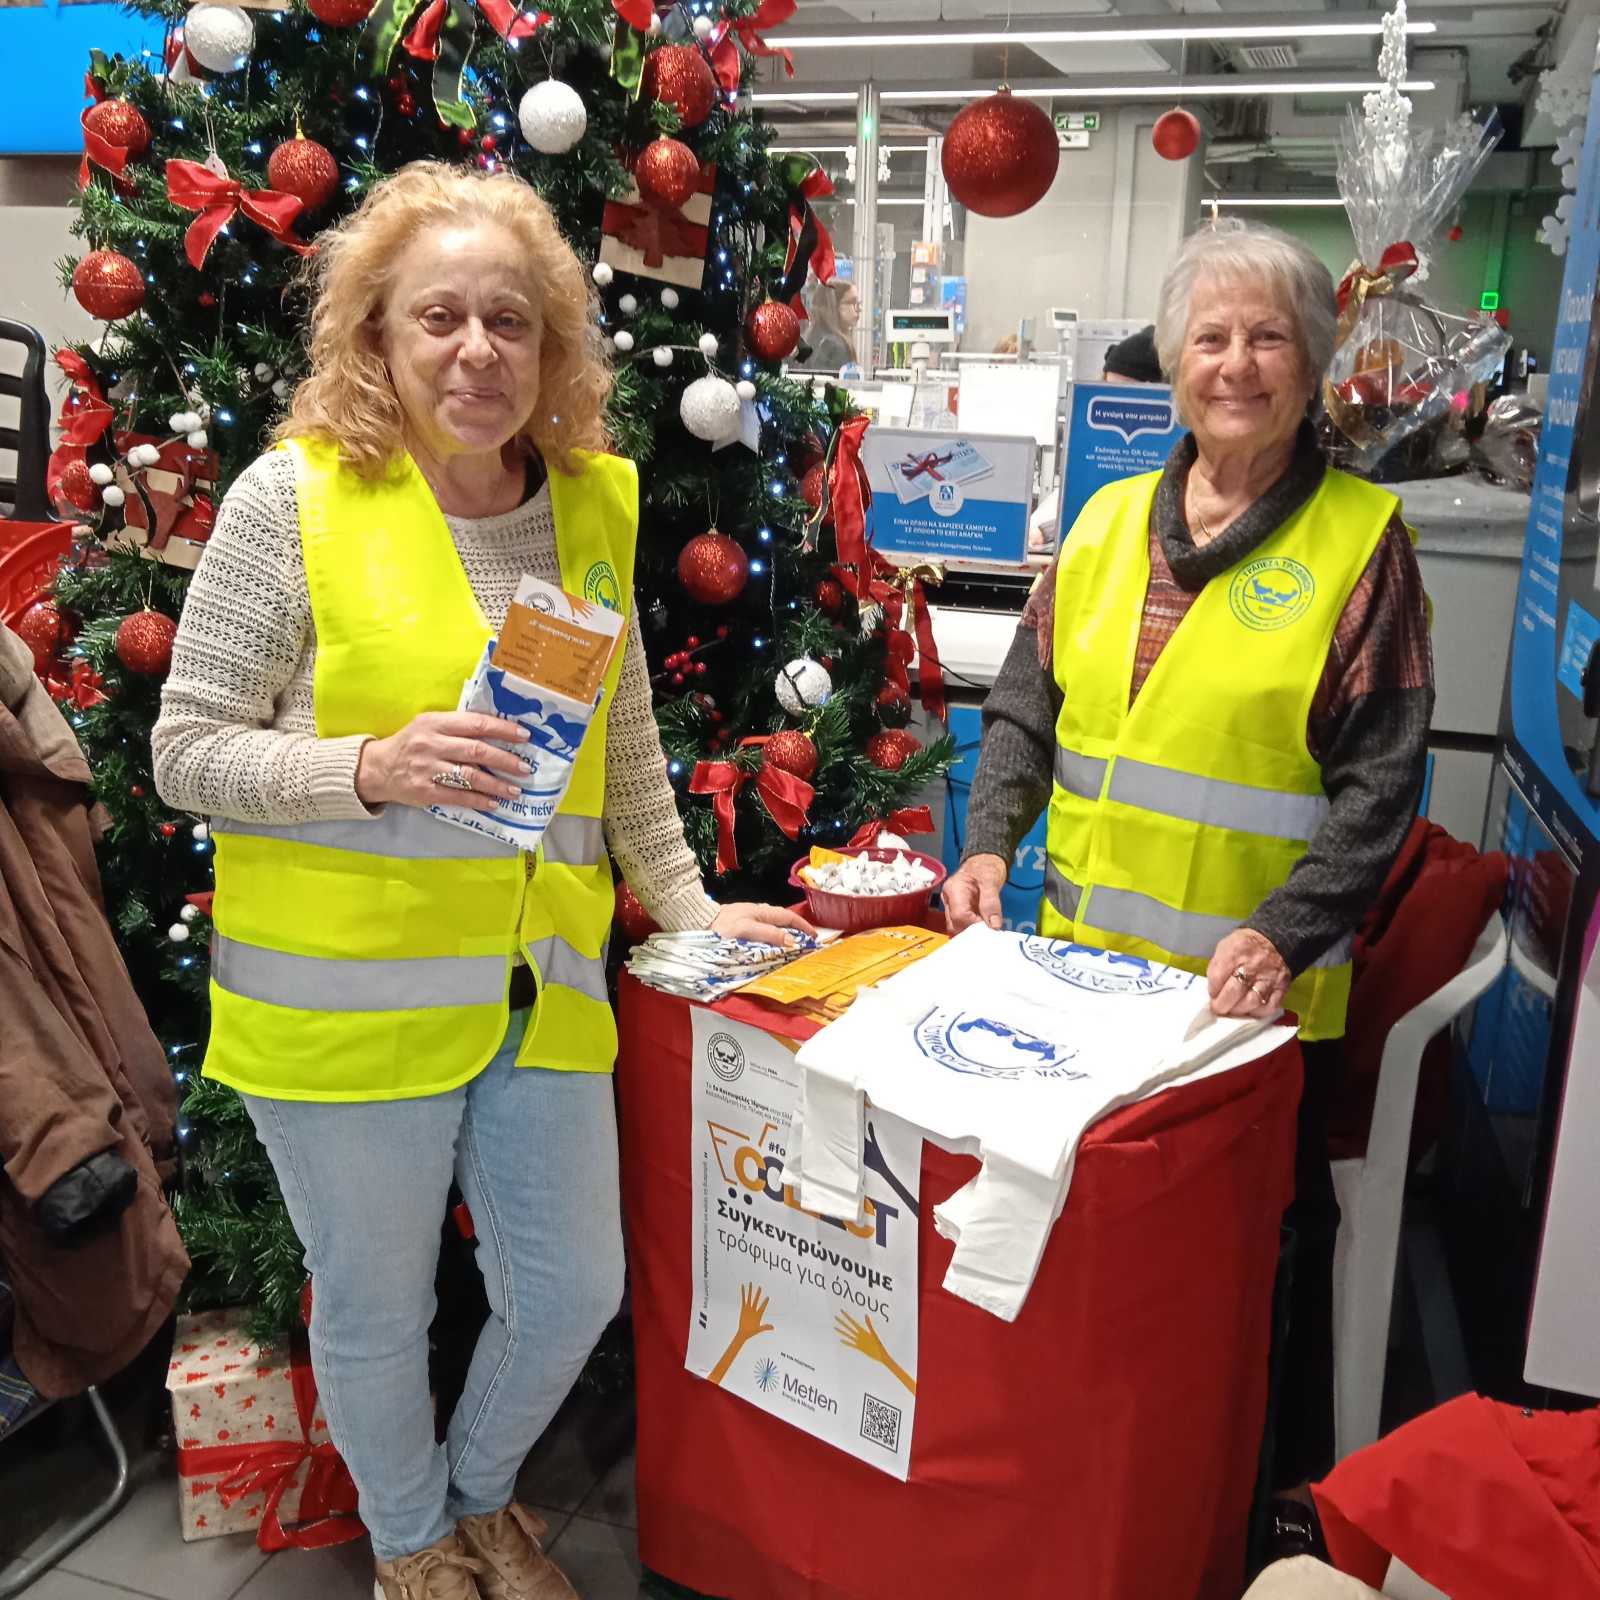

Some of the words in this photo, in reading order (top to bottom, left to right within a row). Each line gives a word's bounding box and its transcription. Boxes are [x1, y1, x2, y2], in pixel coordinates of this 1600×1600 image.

[1095, 409, 1101, 417] Η
[1102, 410, 1124, 420] γνώμη
[1143, 449, 1159, 457] Code
[768, 1142, 787, 1157] #fo
[734, 1146, 899, 1248] COLCT
[717, 1198, 893, 1291] Συγκεντρώνουμε
[717, 1228, 792, 1274] τρόφιμα
[797, 1264, 826, 1290] για
[831, 1276, 890, 1322] όλους
[783, 1373, 838, 1415] Metlen
